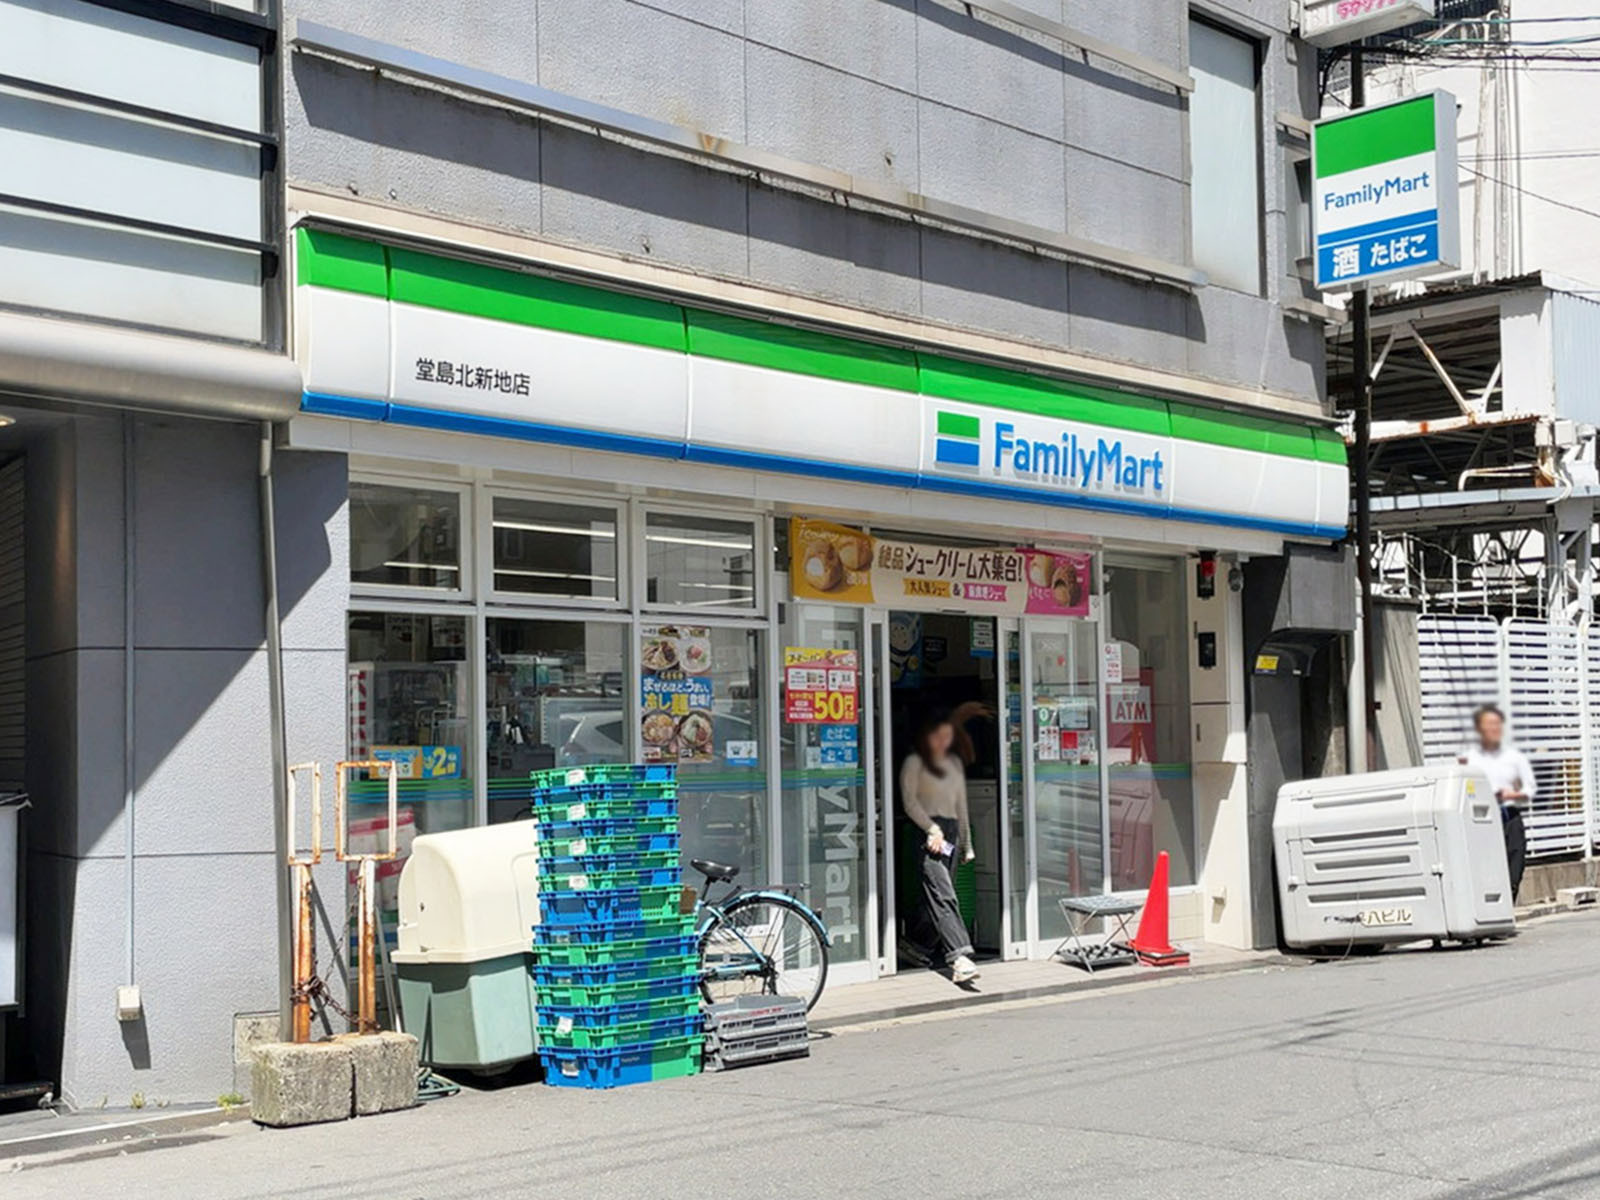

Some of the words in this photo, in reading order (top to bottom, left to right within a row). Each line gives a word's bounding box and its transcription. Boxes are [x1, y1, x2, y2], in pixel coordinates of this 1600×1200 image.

[1324, 171, 1430, 211] FamilyMart
[1332, 244, 1360, 278] 酒
[1370, 233, 1427, 267] たばこ
[415, 357, 531, 396] 堂島北新地店
[994, 422, 1164, 491] FamilyMart
[1115, 700, 1148, 720] ATM
